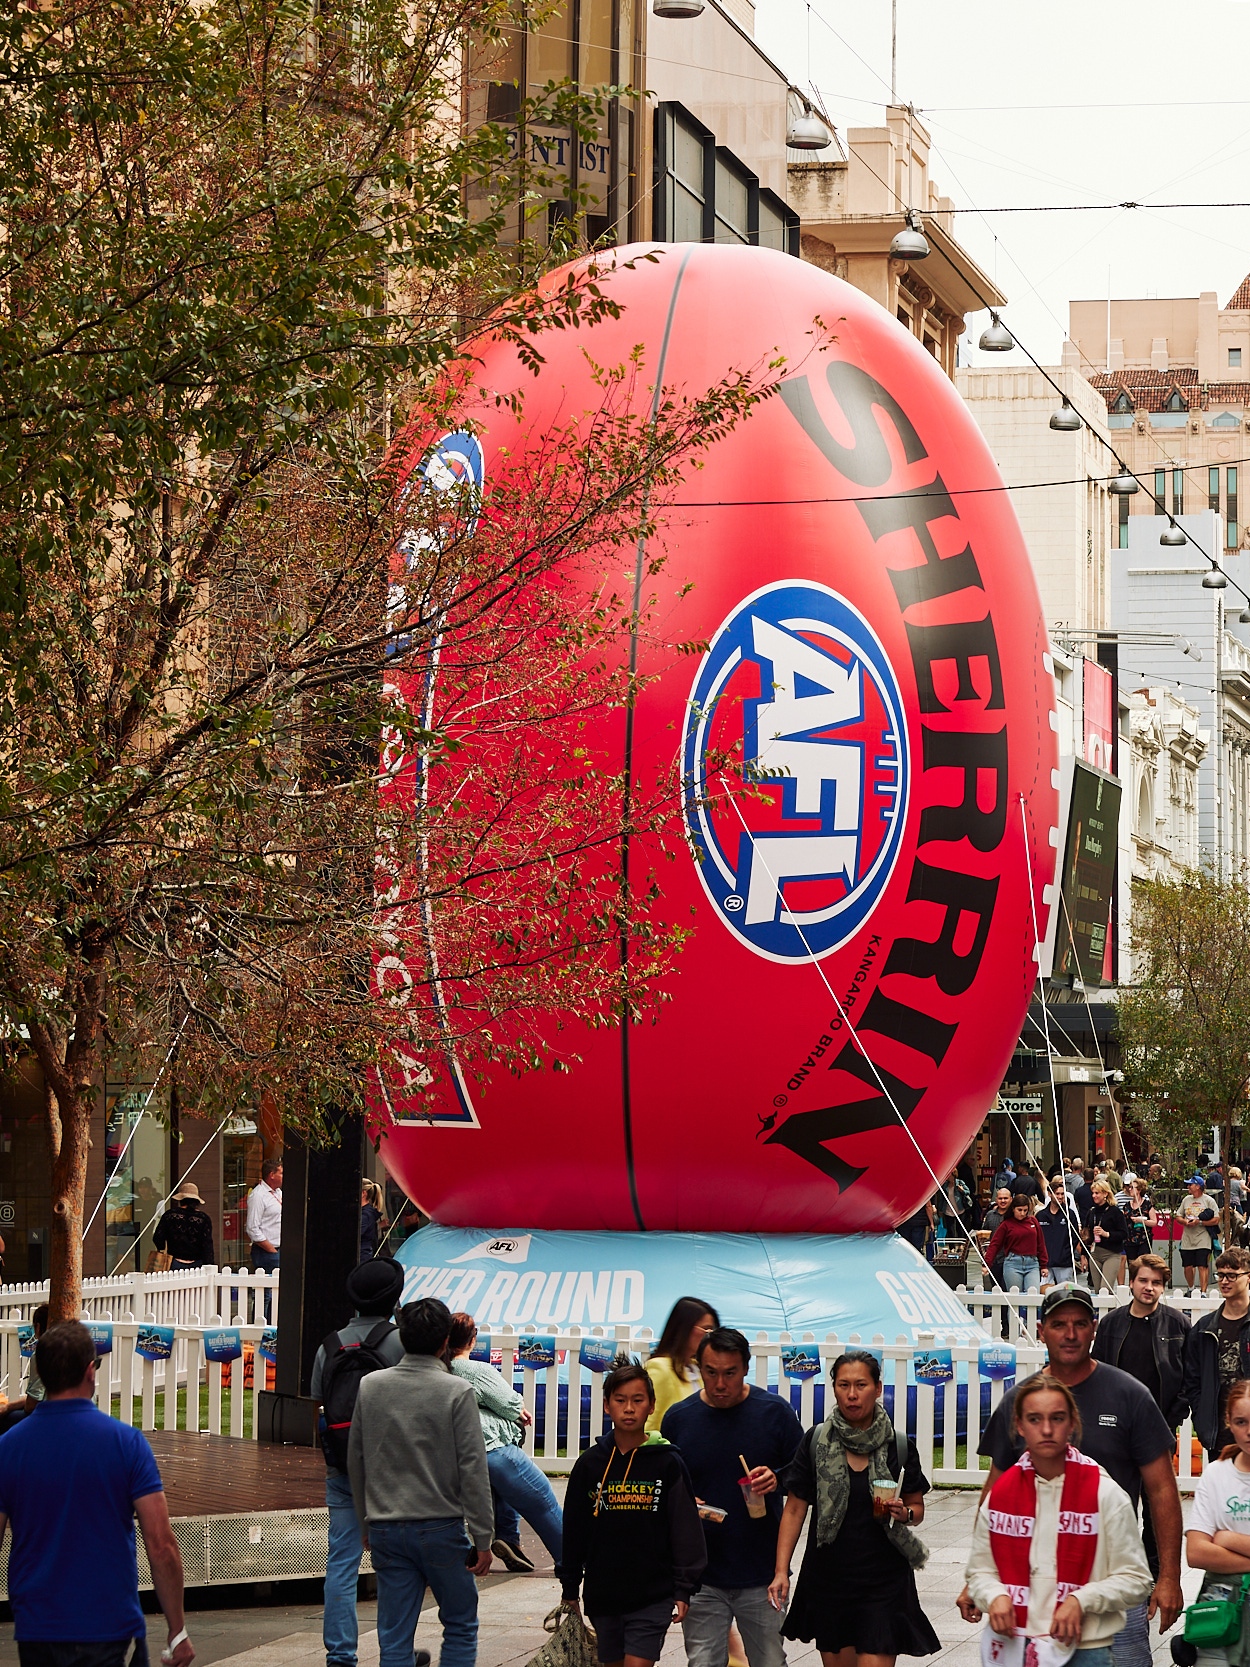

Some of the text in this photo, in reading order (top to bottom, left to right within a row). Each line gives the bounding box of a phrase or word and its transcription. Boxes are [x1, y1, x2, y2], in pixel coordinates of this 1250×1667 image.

[744, 614, 861, 925] AFL
[764, 362, 1010, 1195] SHERRIN
[787, 934, 883, 1091] KANGAROO BRAND
[489, 1241, 516, 1252] AFL
[475, 1269, 645, 1324] ROUND
[608, 1485, 654, 1494] HOCKEY
[989, 1512, 1031, 1535] SWANS
